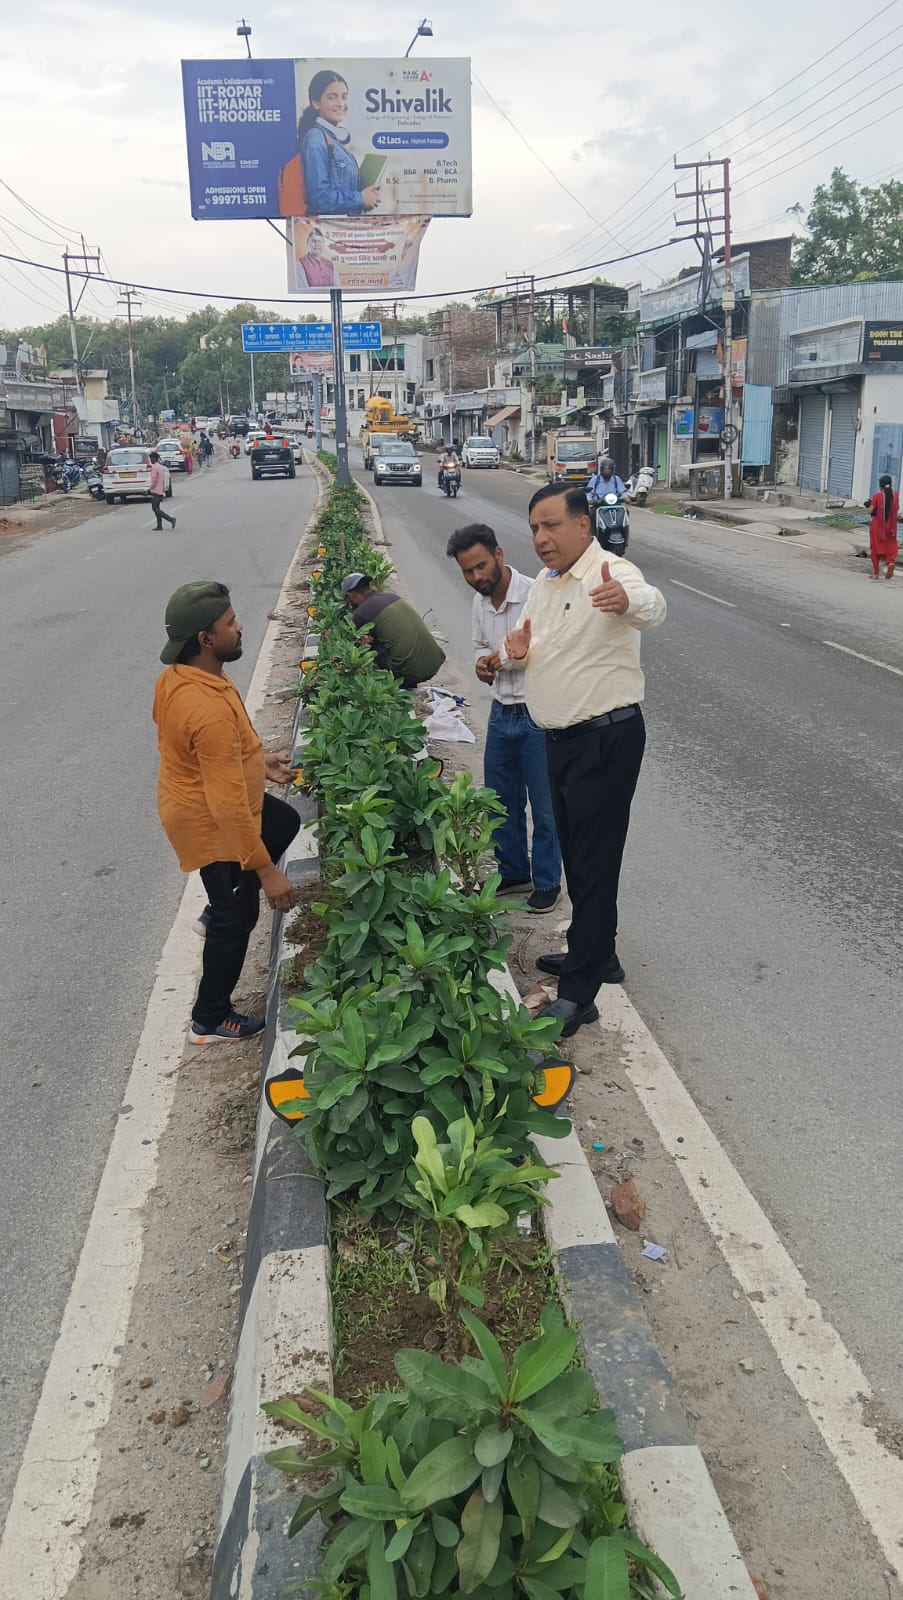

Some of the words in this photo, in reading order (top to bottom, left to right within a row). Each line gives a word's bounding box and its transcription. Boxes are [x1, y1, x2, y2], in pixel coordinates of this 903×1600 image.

[197, 86, 262, 98] IIT-ROPAR
[198, 98, 261, 110] IIT-MANDI
[365, 88, 453, 113] Shivalik
[199, 110, 281, 122] IIT-ROORKEE
[377, 136, 386, 144] 42
[387, 136, 401, 144] Lacs
[202, 142, 236, 160] NBA
[205, 186, 246, 194] ADMISSIONS
[212, 195, 240, 204] 99971
[242, 195, 266, 204] 55111
